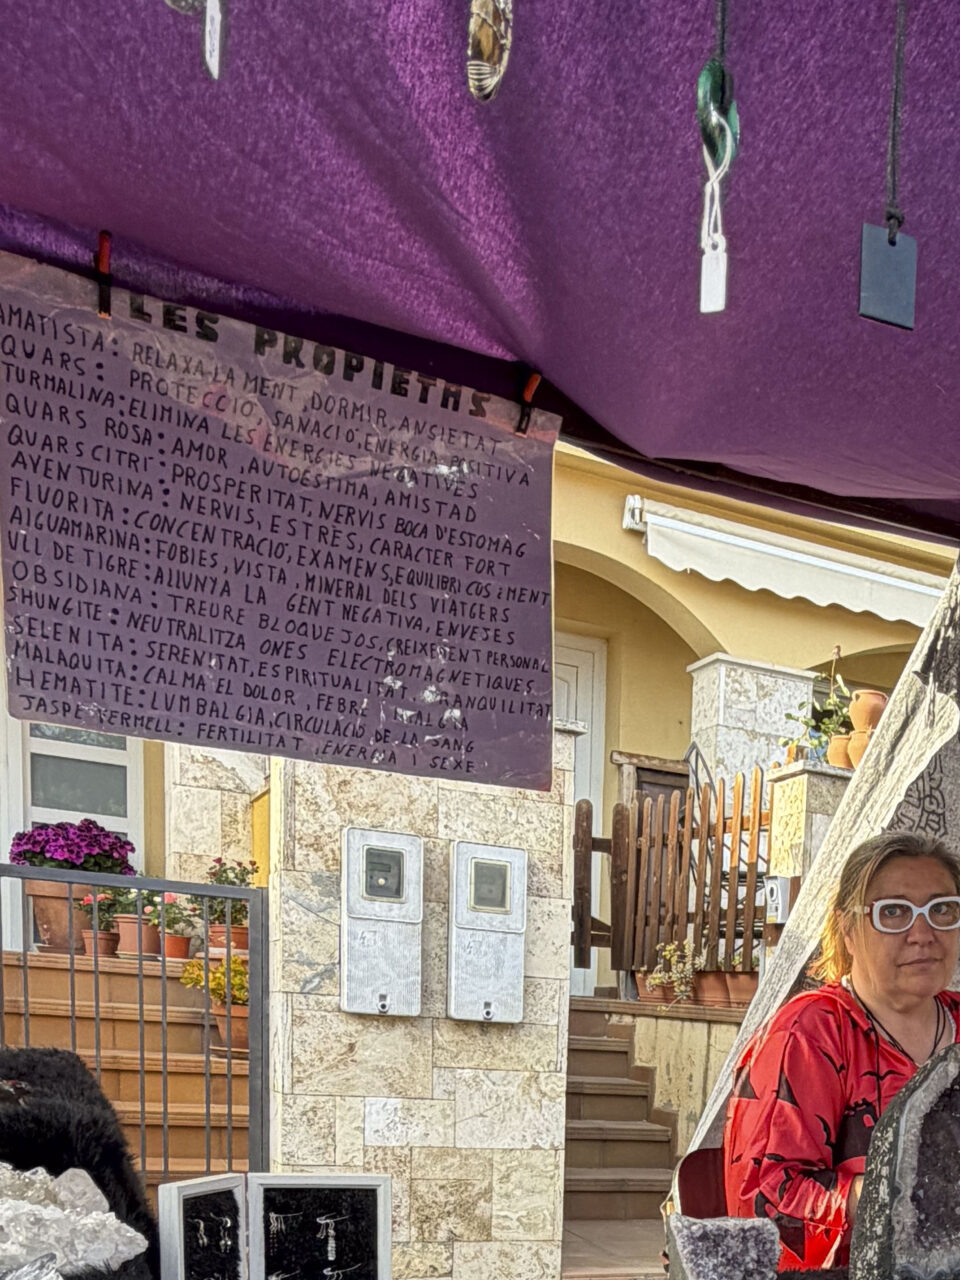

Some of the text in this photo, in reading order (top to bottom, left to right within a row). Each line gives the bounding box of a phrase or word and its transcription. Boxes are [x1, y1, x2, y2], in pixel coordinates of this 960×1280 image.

[6, 393, 87, 429] QUARS
[385, 489, 477, 522] AMISTAD
[319, 501, 386, 529] NERVIS
[394, 517, 428, 539] BOCA
[369, 537, 453, 568] CARACTER
[465, 555, 511, 577] FORT
[53, 541, 75, 563] DE
[245, 584, 266, 605] LA
[286, 593, 335, 616] GENT
[167, 594, 245, 625] TREURE
[383, 588, 417, 610] DELS
[431, 597, 510, 623] VIATGERS
[126, 611, 245, 650] NEUTRALITZA
[259, 639, 308, 660] ONES
[143, 666, 205, 692] CALMA
[215, 678, 233, 695] EL
[426, 685, 552, 717] RANQUILITAT
[197, 723, 303, 750] FERTILITAT
